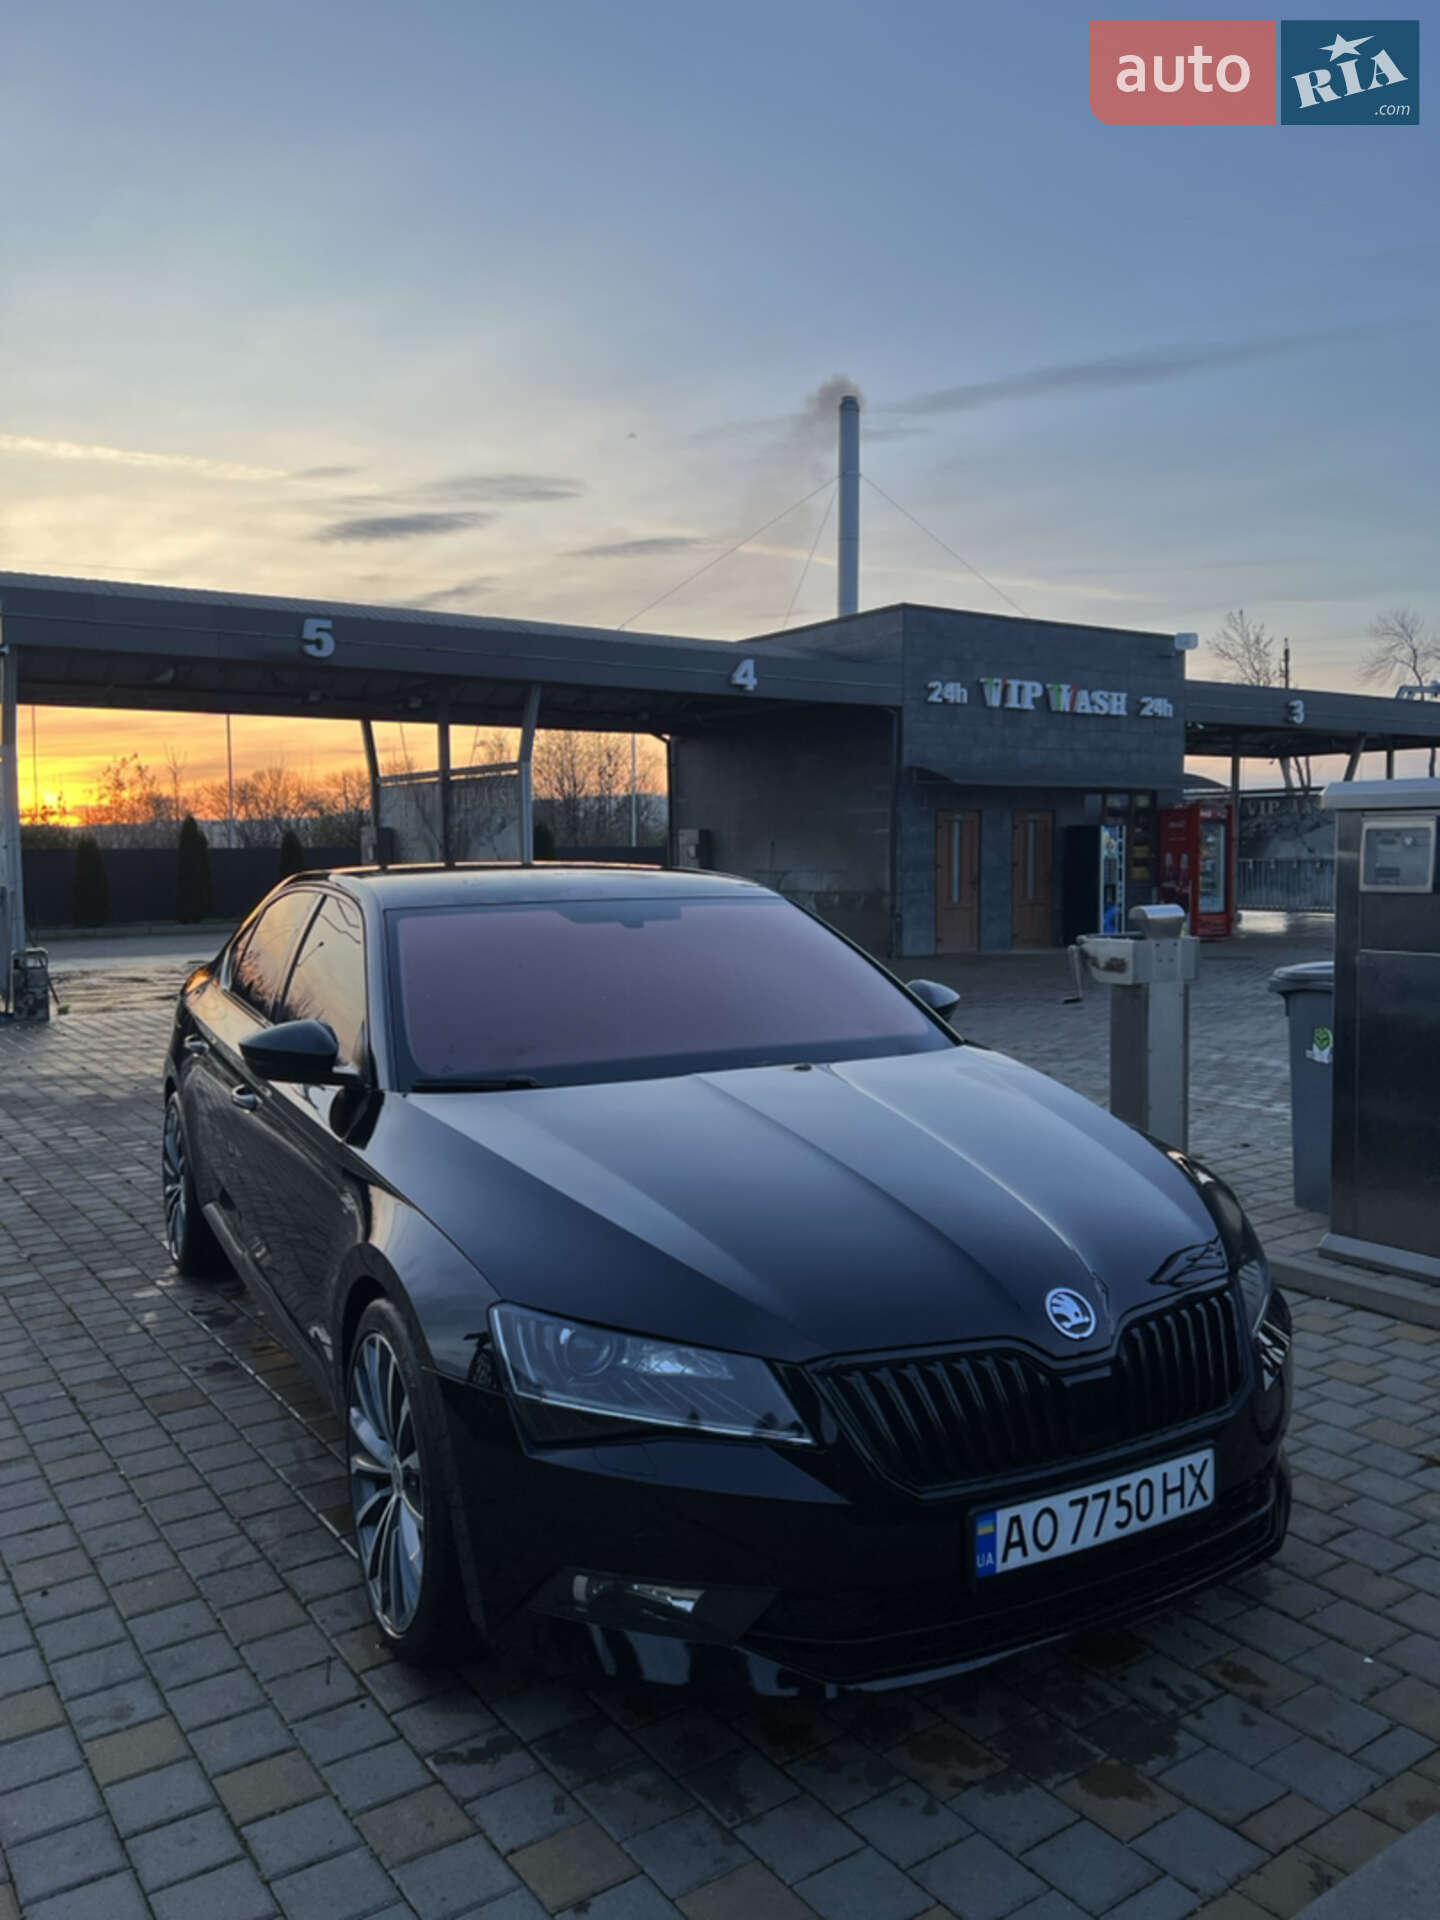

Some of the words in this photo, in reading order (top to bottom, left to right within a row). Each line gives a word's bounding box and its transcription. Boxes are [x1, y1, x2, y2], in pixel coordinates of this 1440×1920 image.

[302, 618, 336, 658] 5
[731, 658, 759, 692] 4
[927, 680, 968, 704] 24h
[980, 677, 1044, 709] VIP
[1047, 683, 1129, 716] WASH
[1139, 696, 1174, 718] 24h
[1288, 699, 1305, 724] 3
[1001, 1506, 1059, 1564] AO
[1068, 1478, 1155, 1545] 7750
[1161, 1457, 1210, 1516] HX
[976, 1552, 995, 1568] UA
